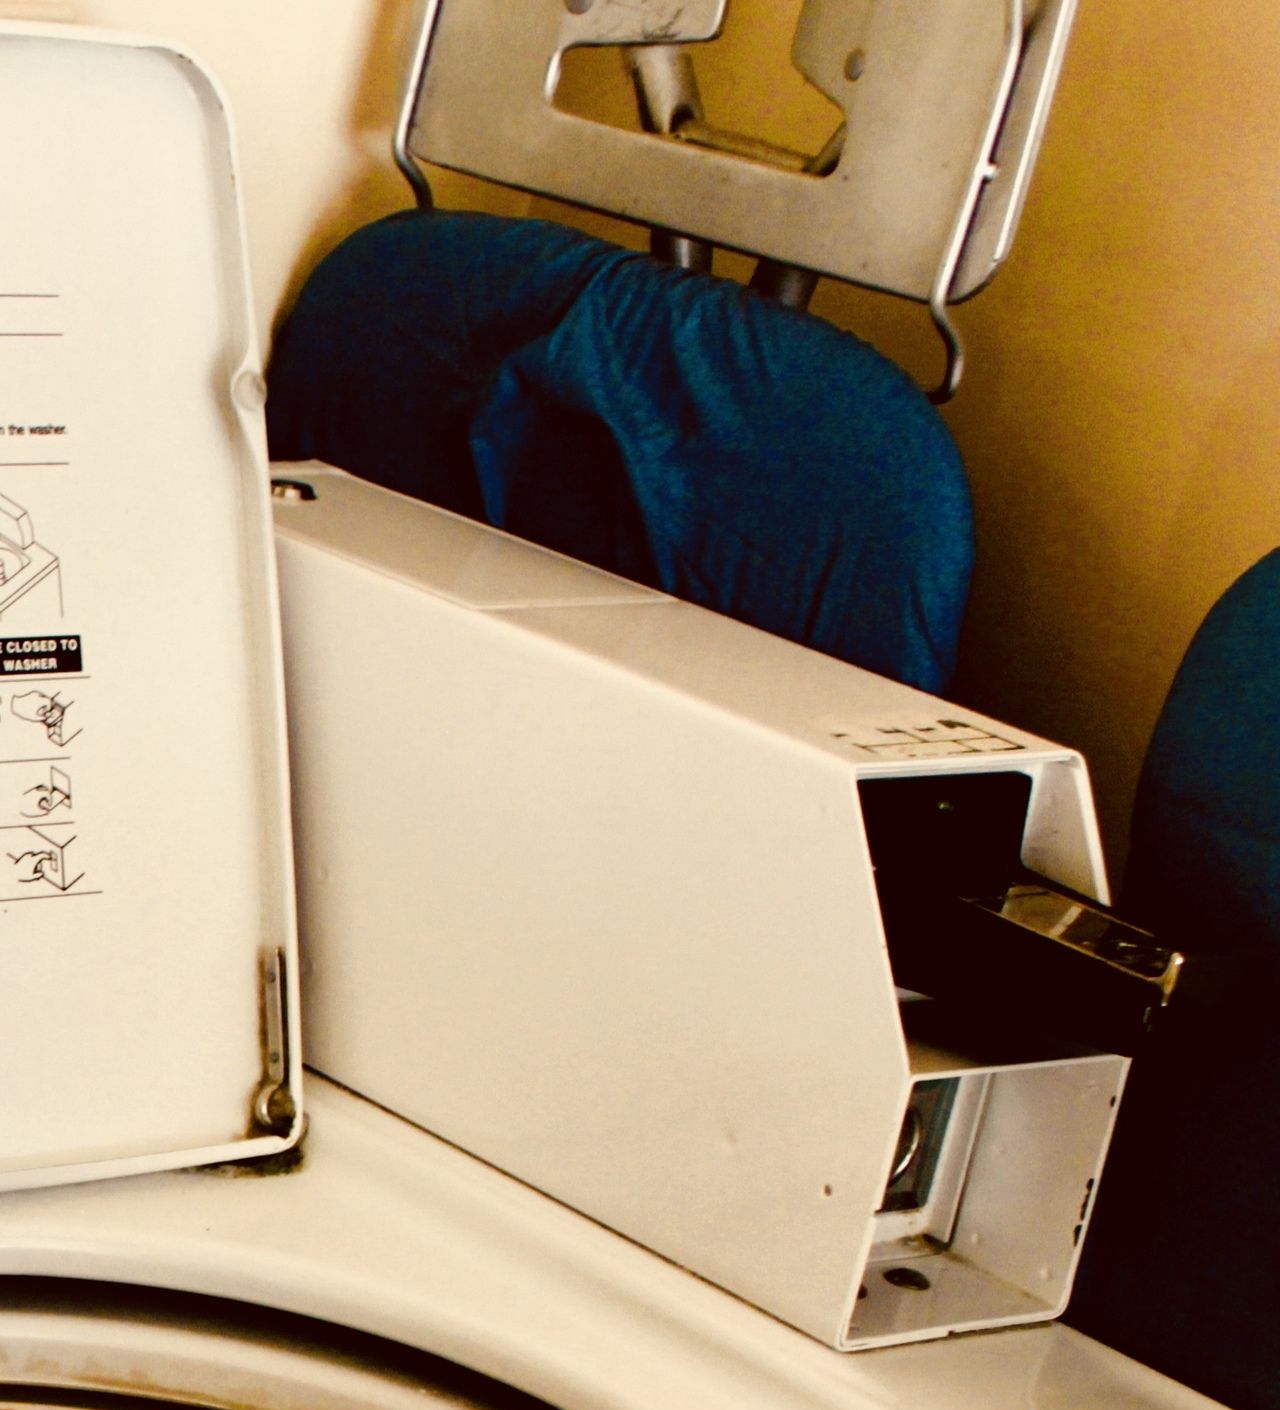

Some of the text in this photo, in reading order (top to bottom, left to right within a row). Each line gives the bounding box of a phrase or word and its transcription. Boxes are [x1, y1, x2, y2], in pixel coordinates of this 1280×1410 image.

[5, 639, 57, 653] CLOSED
[59, 638, 80, 652] TO
[3, 658, 58, 672] WASHER
